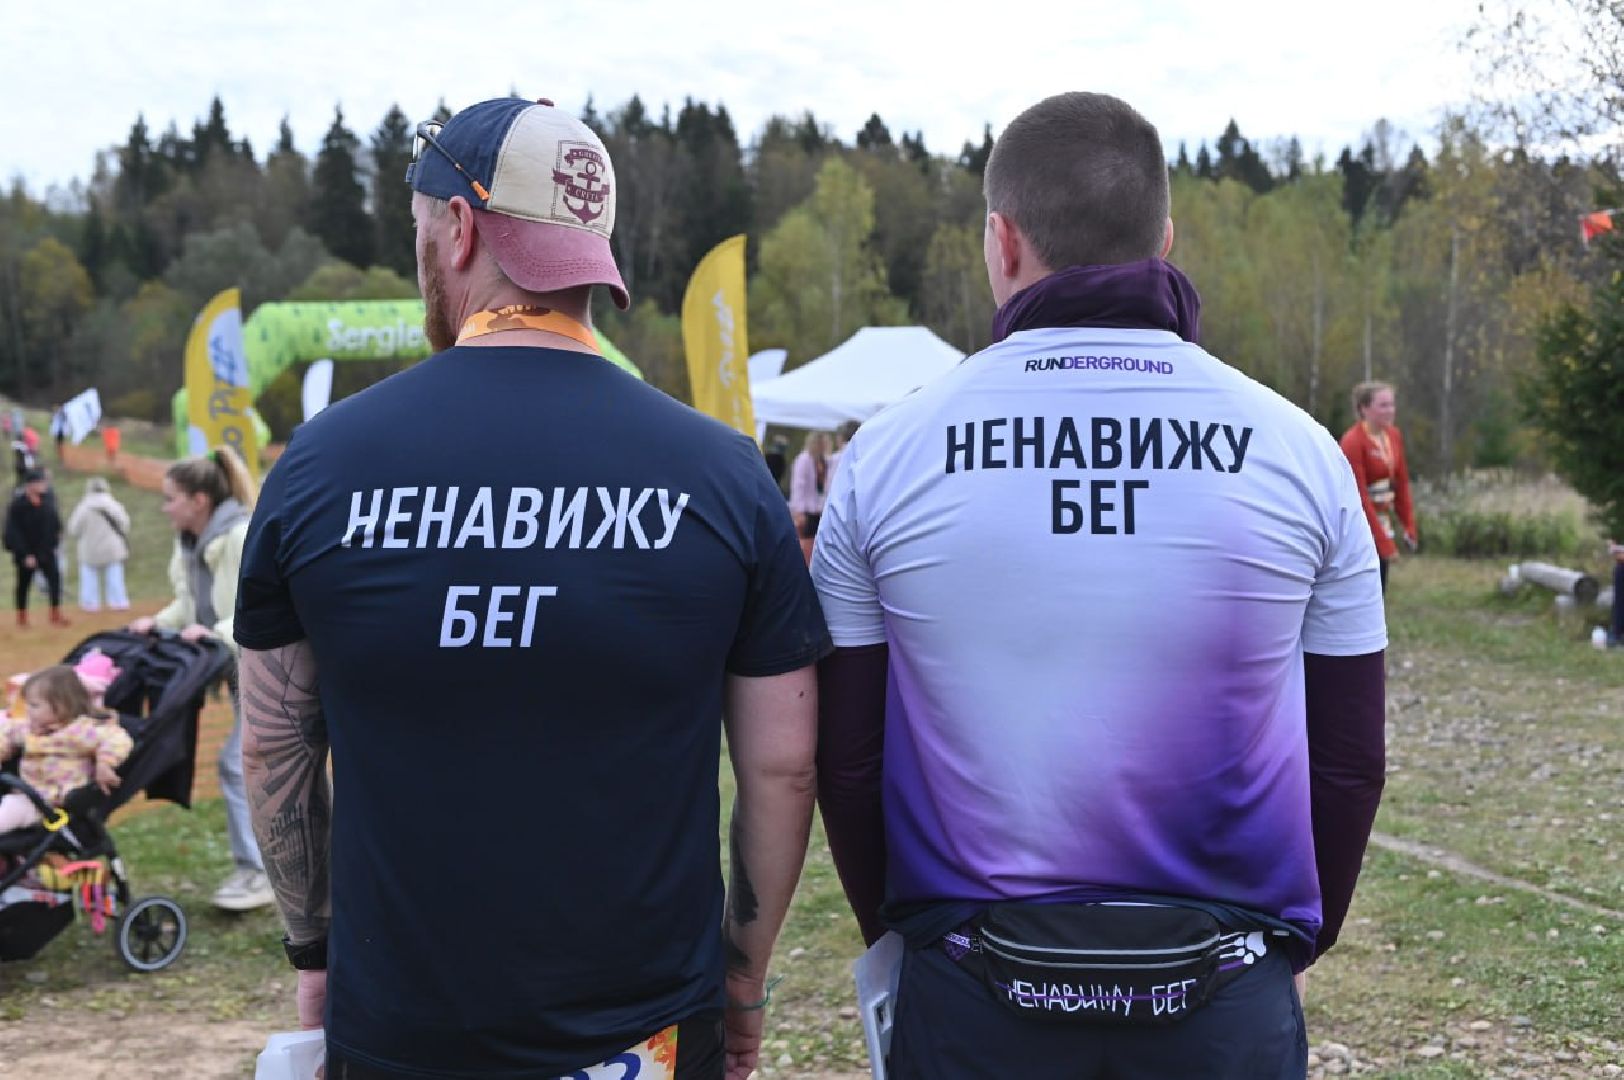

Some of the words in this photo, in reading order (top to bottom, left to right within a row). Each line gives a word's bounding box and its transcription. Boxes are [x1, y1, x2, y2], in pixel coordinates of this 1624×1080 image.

[326, 318, 424, 356] Sergie
[1025, 355, 1174, 374] RUNDERGROUND
[945, 417, 1253, 474] НЕНАВИЖУ
[341, 486, 691, 549] НЕНАВИЖУ
[1051, 479, 1149, 535] БЕГ
[439, 585, 558, 648] БЕГ
[1151, 978, 1197, 1016] БЕГ
